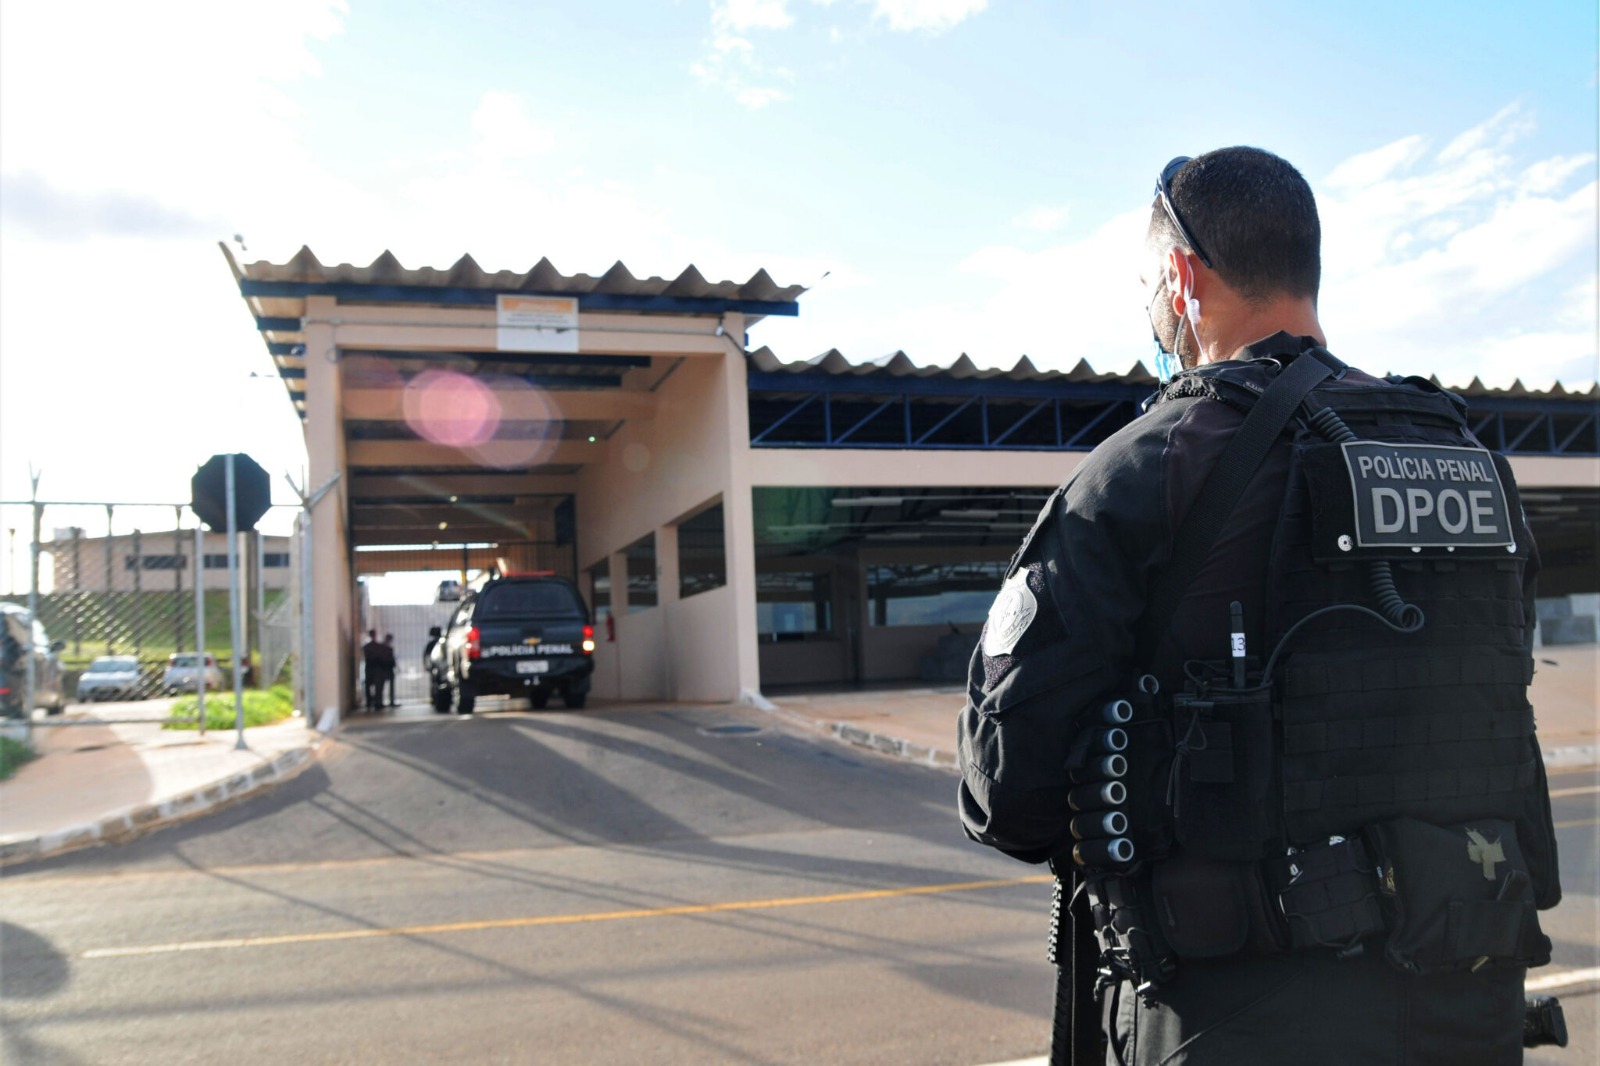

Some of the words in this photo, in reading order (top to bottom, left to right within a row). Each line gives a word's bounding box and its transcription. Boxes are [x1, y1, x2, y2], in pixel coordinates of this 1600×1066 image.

[1358, 452, 1436, 480] POLÍCIA
[1435, 458, 1493, 482] PENAL
[1371, 487, 1498, 534] DPOE
[537, 643, 573, 655] PENAL
